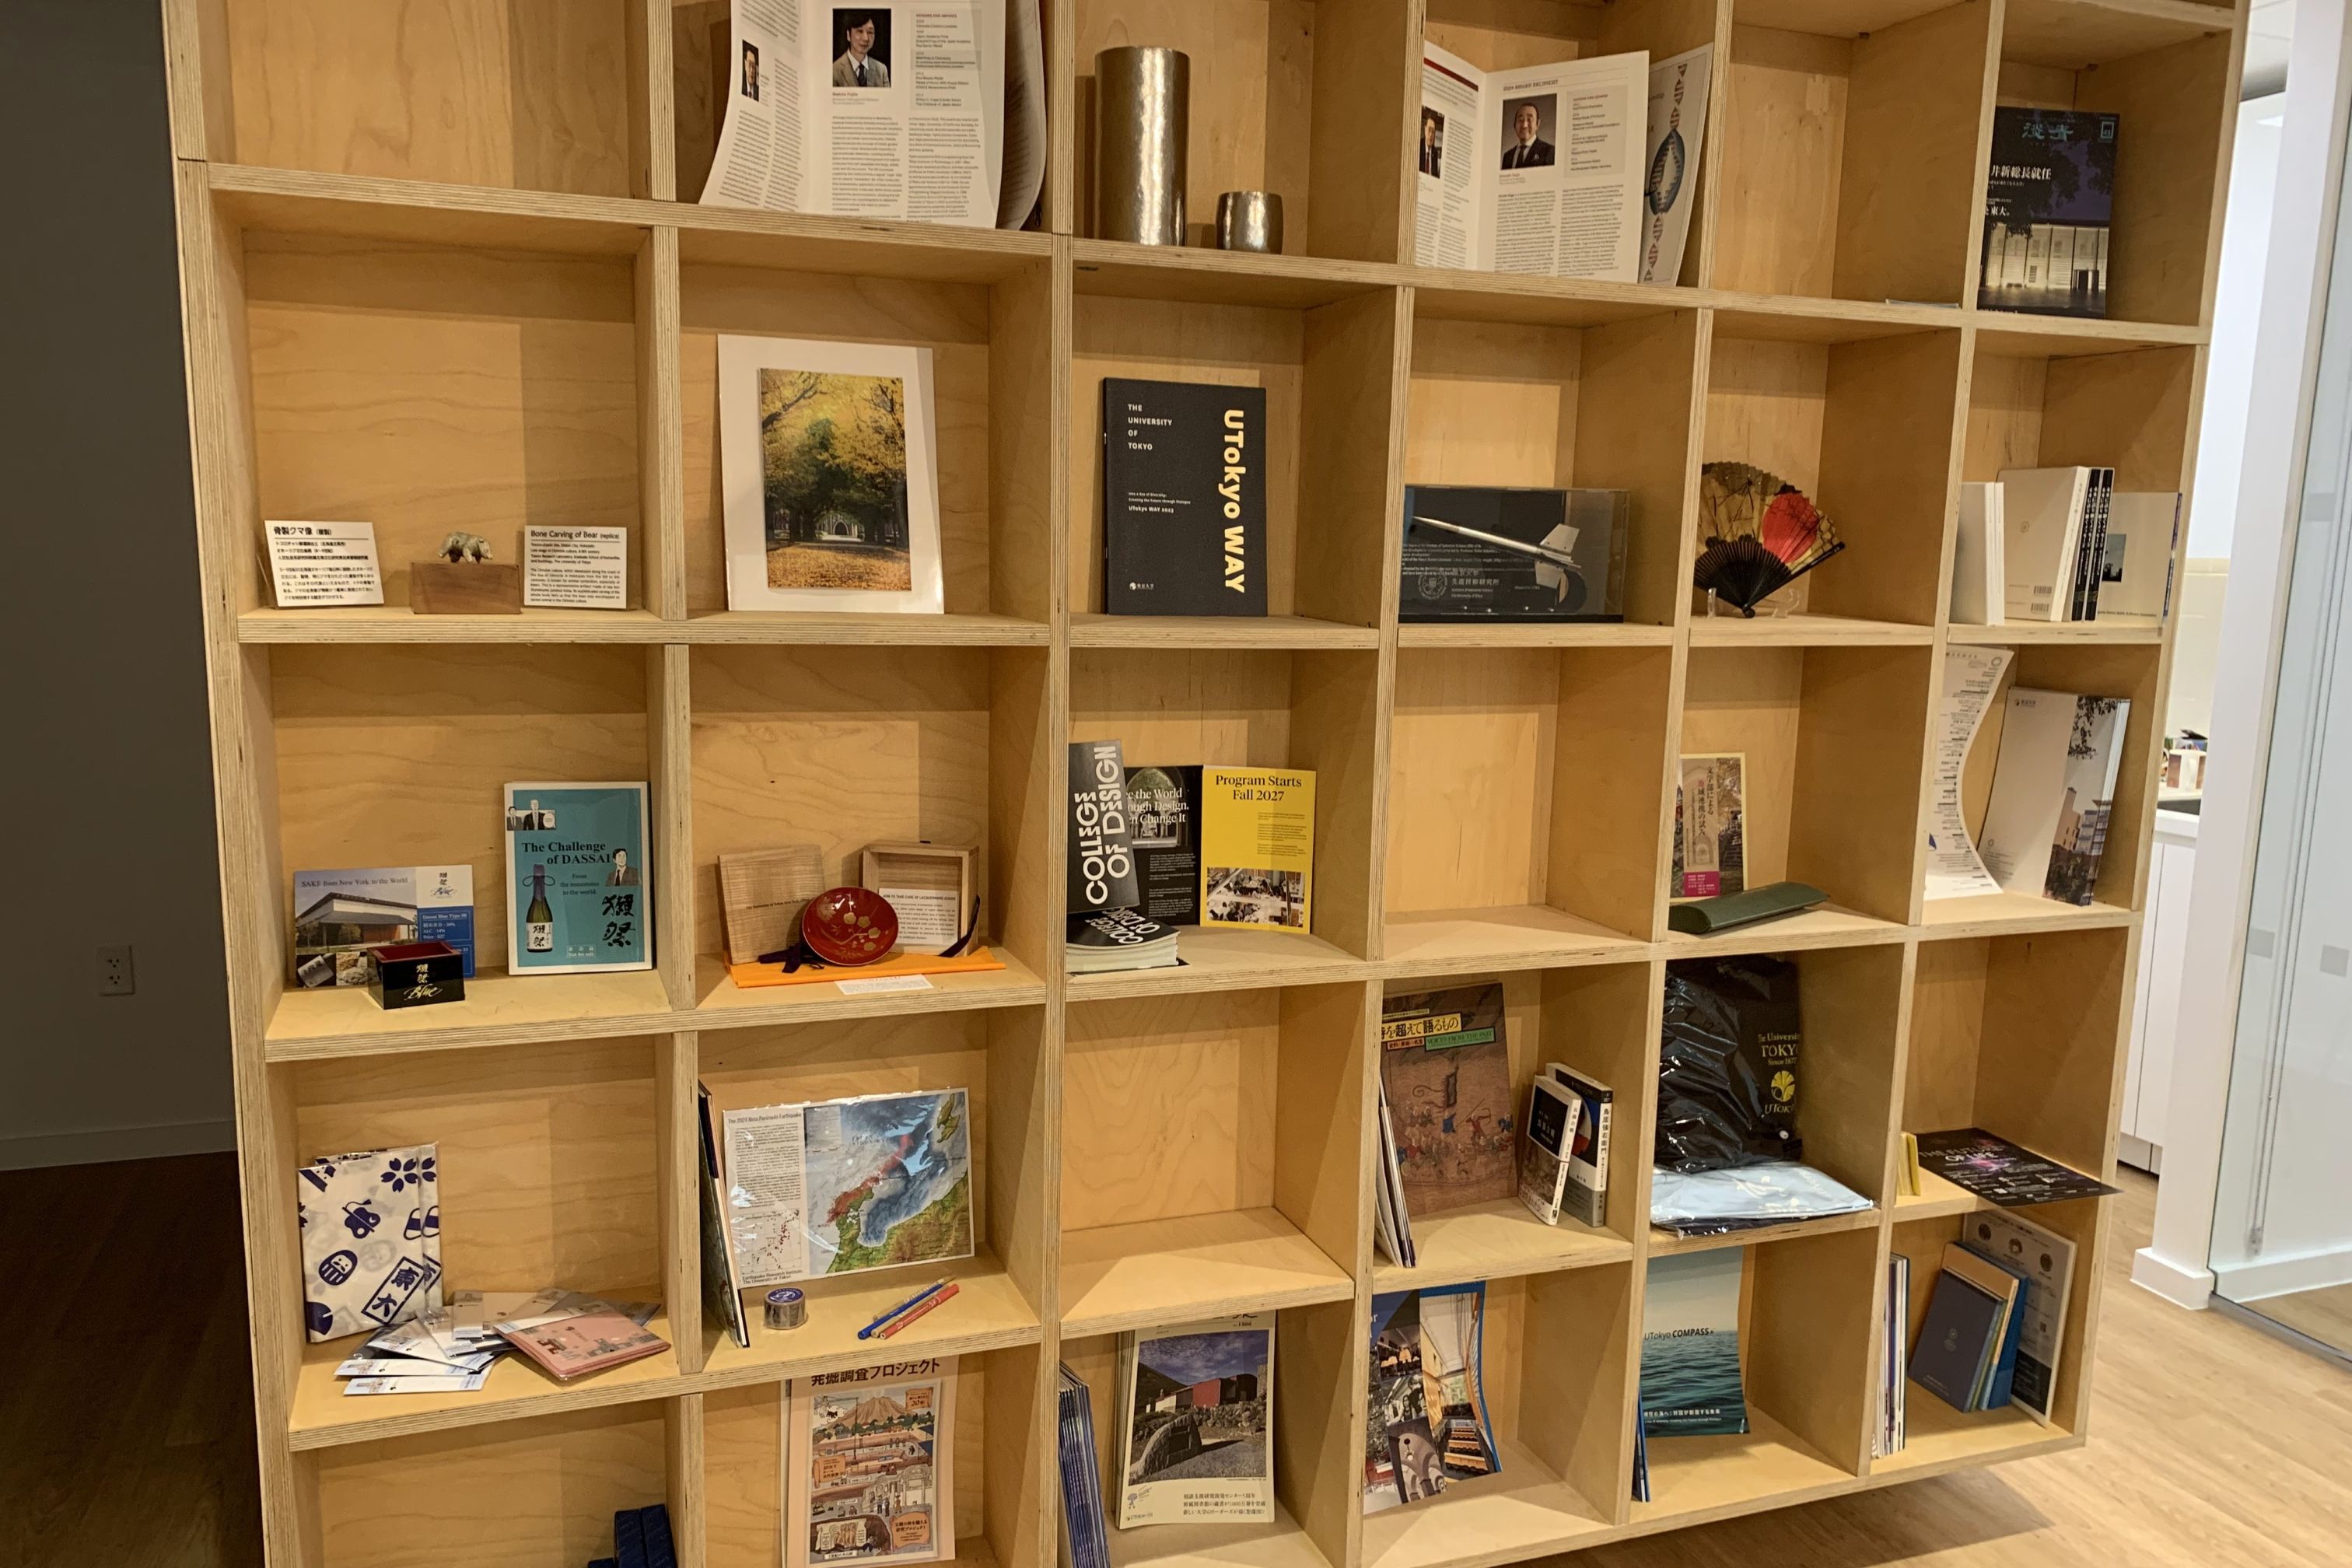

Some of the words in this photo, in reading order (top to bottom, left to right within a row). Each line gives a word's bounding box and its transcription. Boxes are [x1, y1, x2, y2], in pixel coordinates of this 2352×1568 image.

[1128, 417, 1173, 426] UNIVERSITY
[1128, 442, 1153, 450] TOKYO
[1218, 409, 1247, 519] UTokyo
[549, 530, 573, 539] Carving
[1224, 525, 1245, 593] WAY
[1216, 775, 1265, 788] Program
[1268, 775, 1302, 787] Starts
[1094, 745, 1126, 835] DESIGN
[1136, 788, 1152, 800] the
[1153, 787, 1182, 799] World
[1233, 789, 1253, 800] Fall
[1256, 790, 1285, 801] 2027
[1154, 800, 1189, 813] Design.
[1139, 814, 1177, 825] Change
[1178, 813, 1186, 823] It
[522, 842, 544, 852] The
[548, 841, 606, 853] Challenge
[547, 854, 558, 865] of
[562, 853, 611, 864] DASSAI
[1105, 845, 1130, 879] OF
[602, 894, 636, 947] 獺祭
[404, 983, 443, 1001] Blue
[1761, 1044, 1798, 1058] TOKY
[372, 1266, 419, 1318] 東大
[1643, 1332, 1671, 1341] UTokyo
[1672, 1328, 1710, 1338] COMPASS
